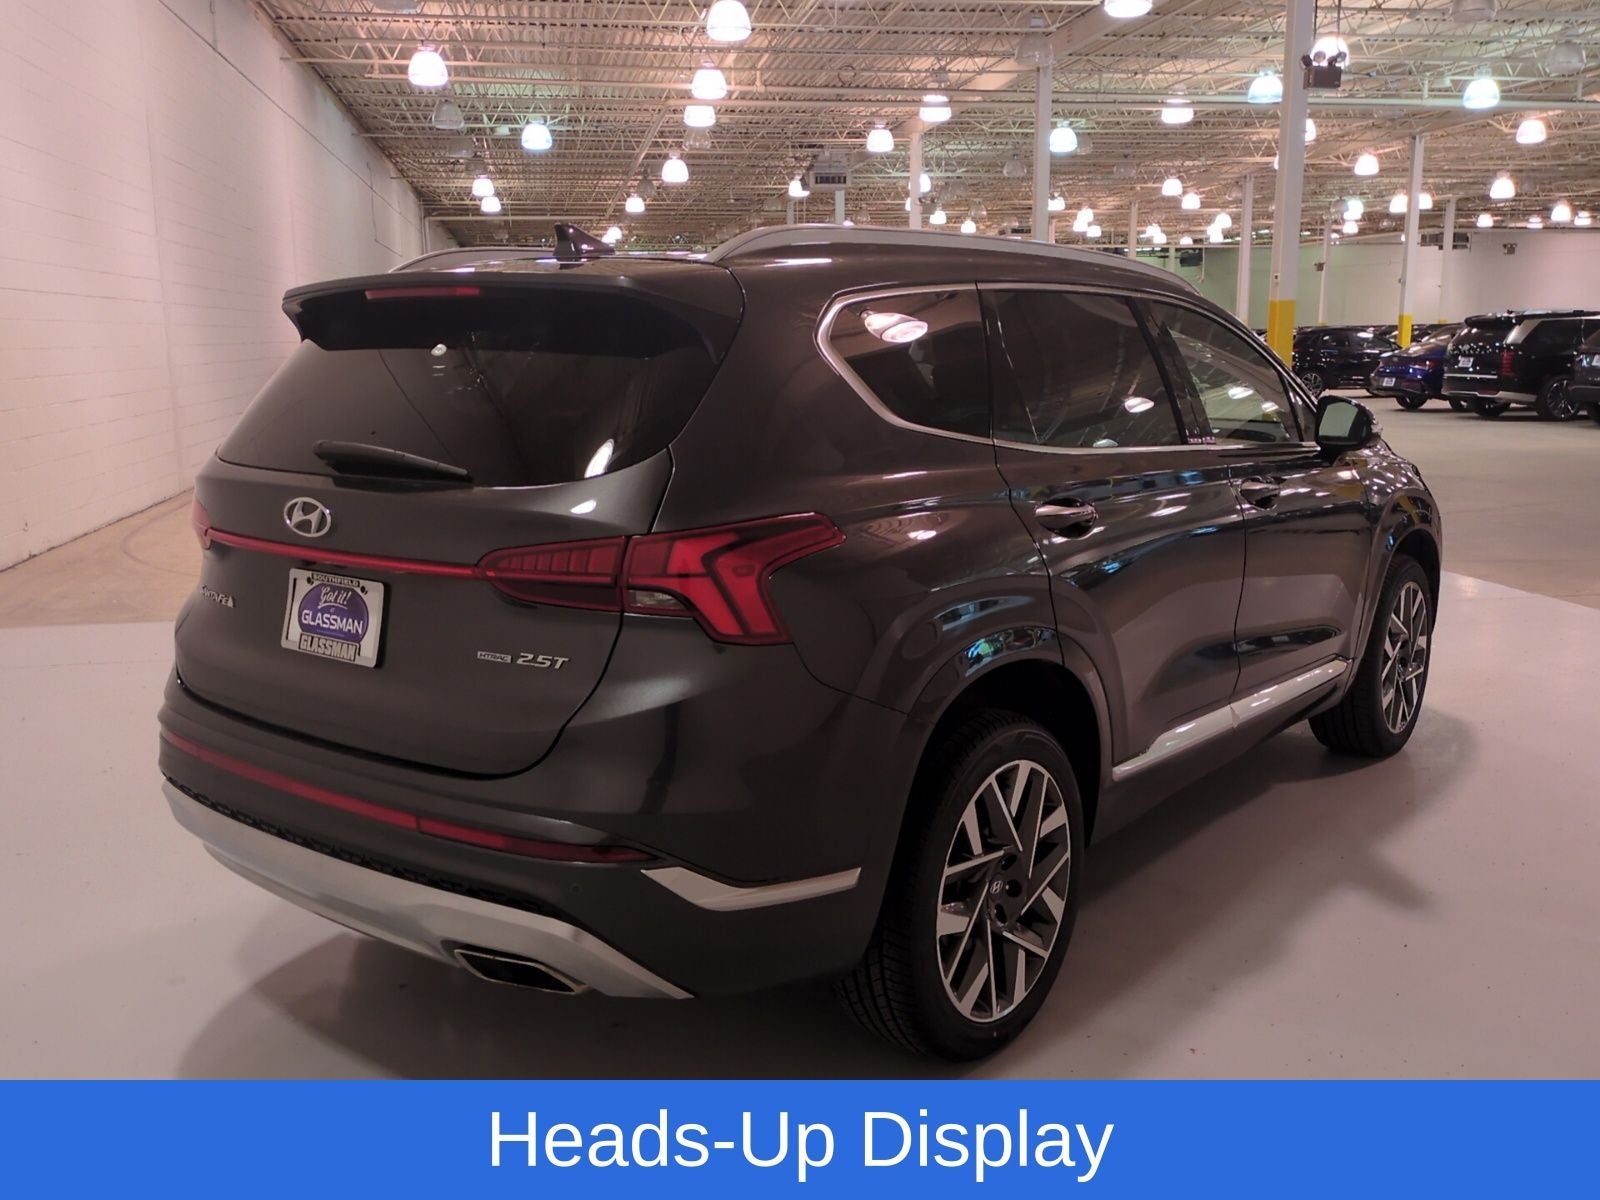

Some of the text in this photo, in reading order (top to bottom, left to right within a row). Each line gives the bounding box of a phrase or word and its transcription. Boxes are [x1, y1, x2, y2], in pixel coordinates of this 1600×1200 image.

[313, 574, 359, 587] SOUTHFIELD
[320, 586, 352, 605] Got it!
[302, 610, 363, 634] GLASSMAN
[300, 635, 357, 661] GLASSMAN
